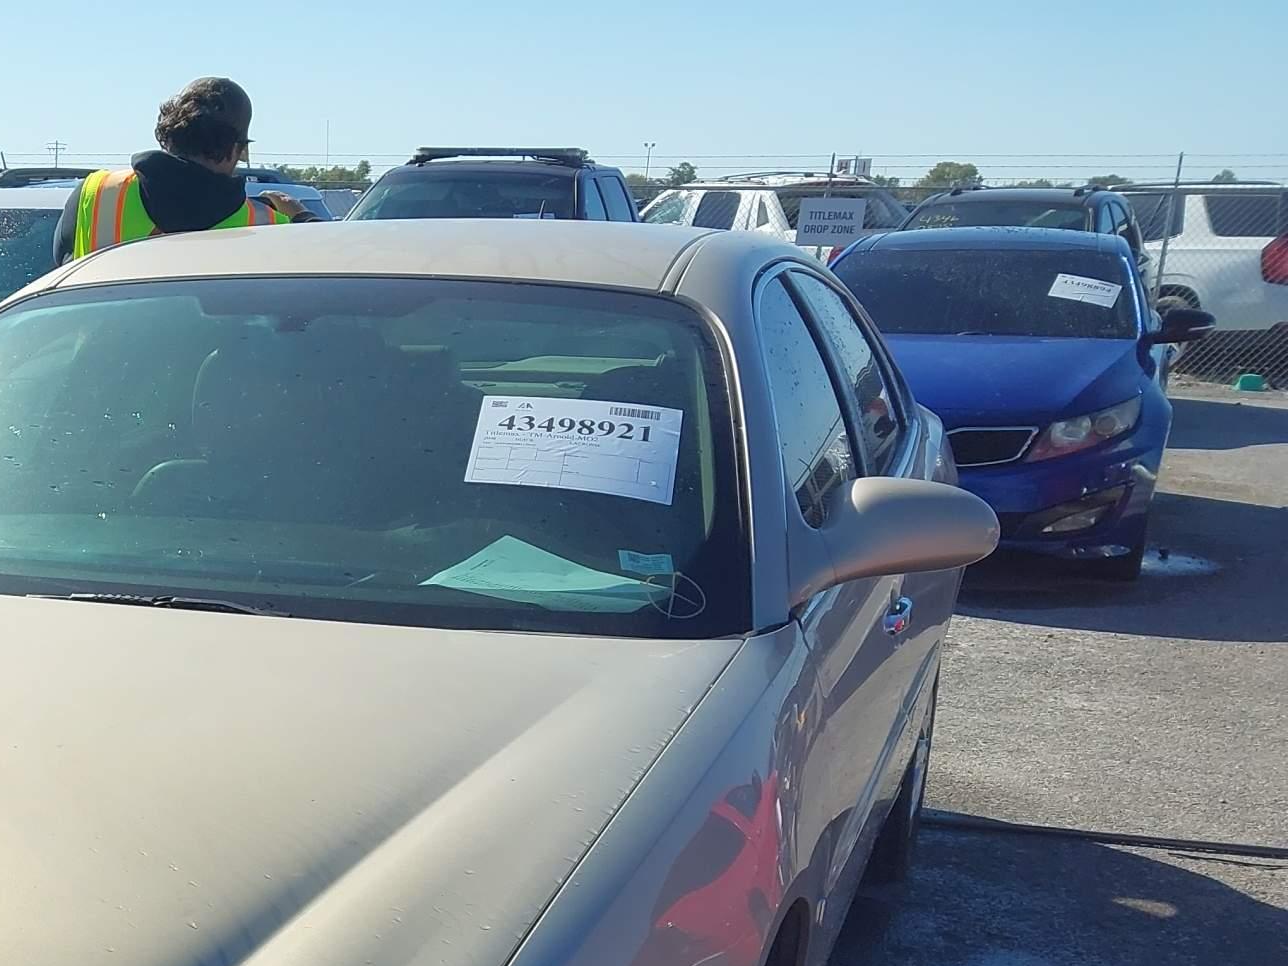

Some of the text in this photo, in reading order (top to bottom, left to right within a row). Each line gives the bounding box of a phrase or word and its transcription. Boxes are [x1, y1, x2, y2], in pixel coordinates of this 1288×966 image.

[808, 210, 855, 221] TITLEMAX
[803, 223, 857, 234] DROP ZONE
[497, 414, 652, 442] 43498921
